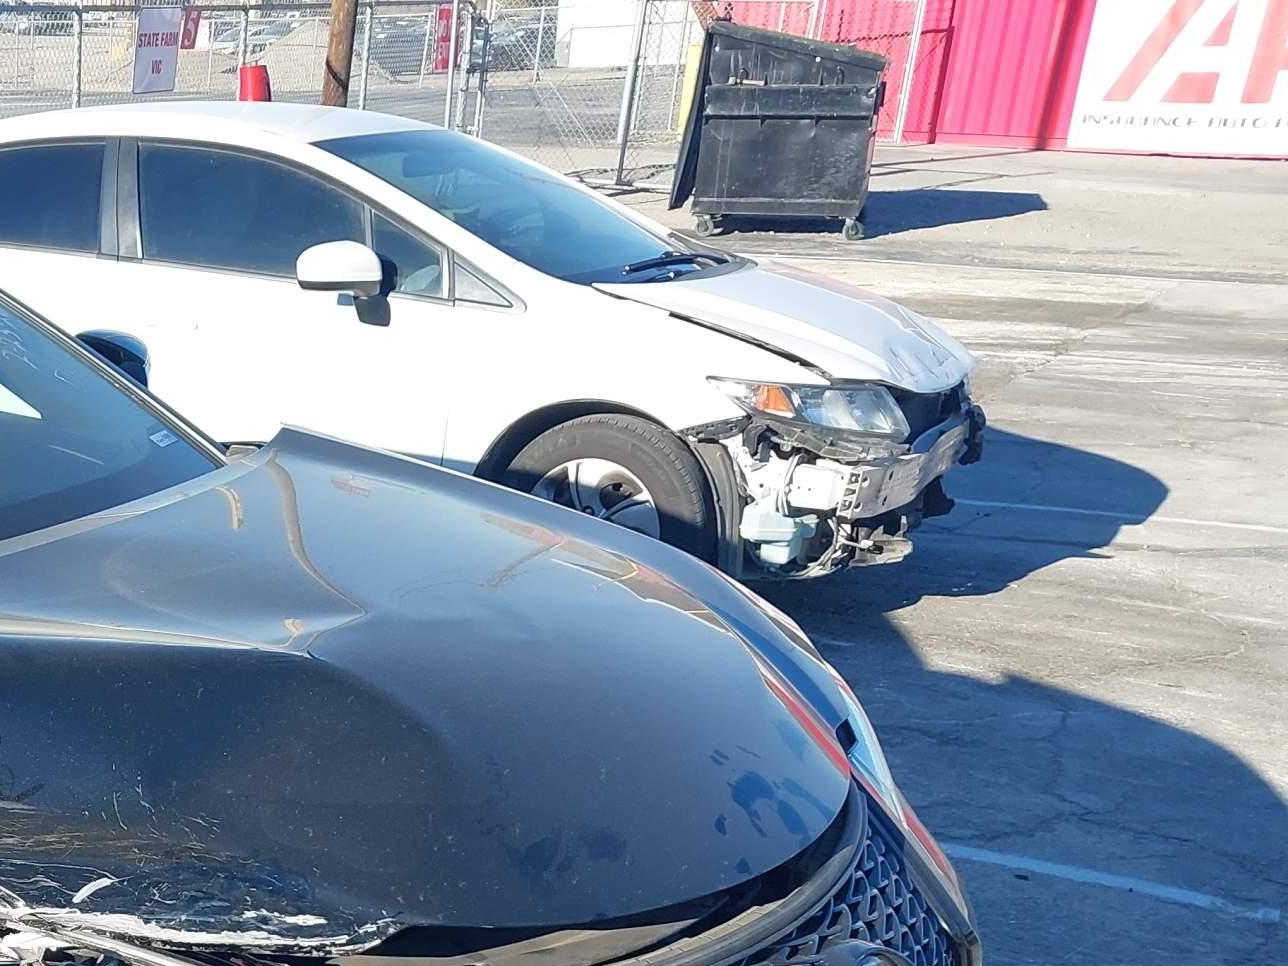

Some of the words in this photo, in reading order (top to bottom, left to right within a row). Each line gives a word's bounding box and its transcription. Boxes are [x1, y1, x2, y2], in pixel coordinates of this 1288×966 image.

[183, 11, 196, 46] 5
[138, 32, 160, 48] STATE
[160, 31, 179, 47] FARM
[151, 59, 162, 74] VIC
